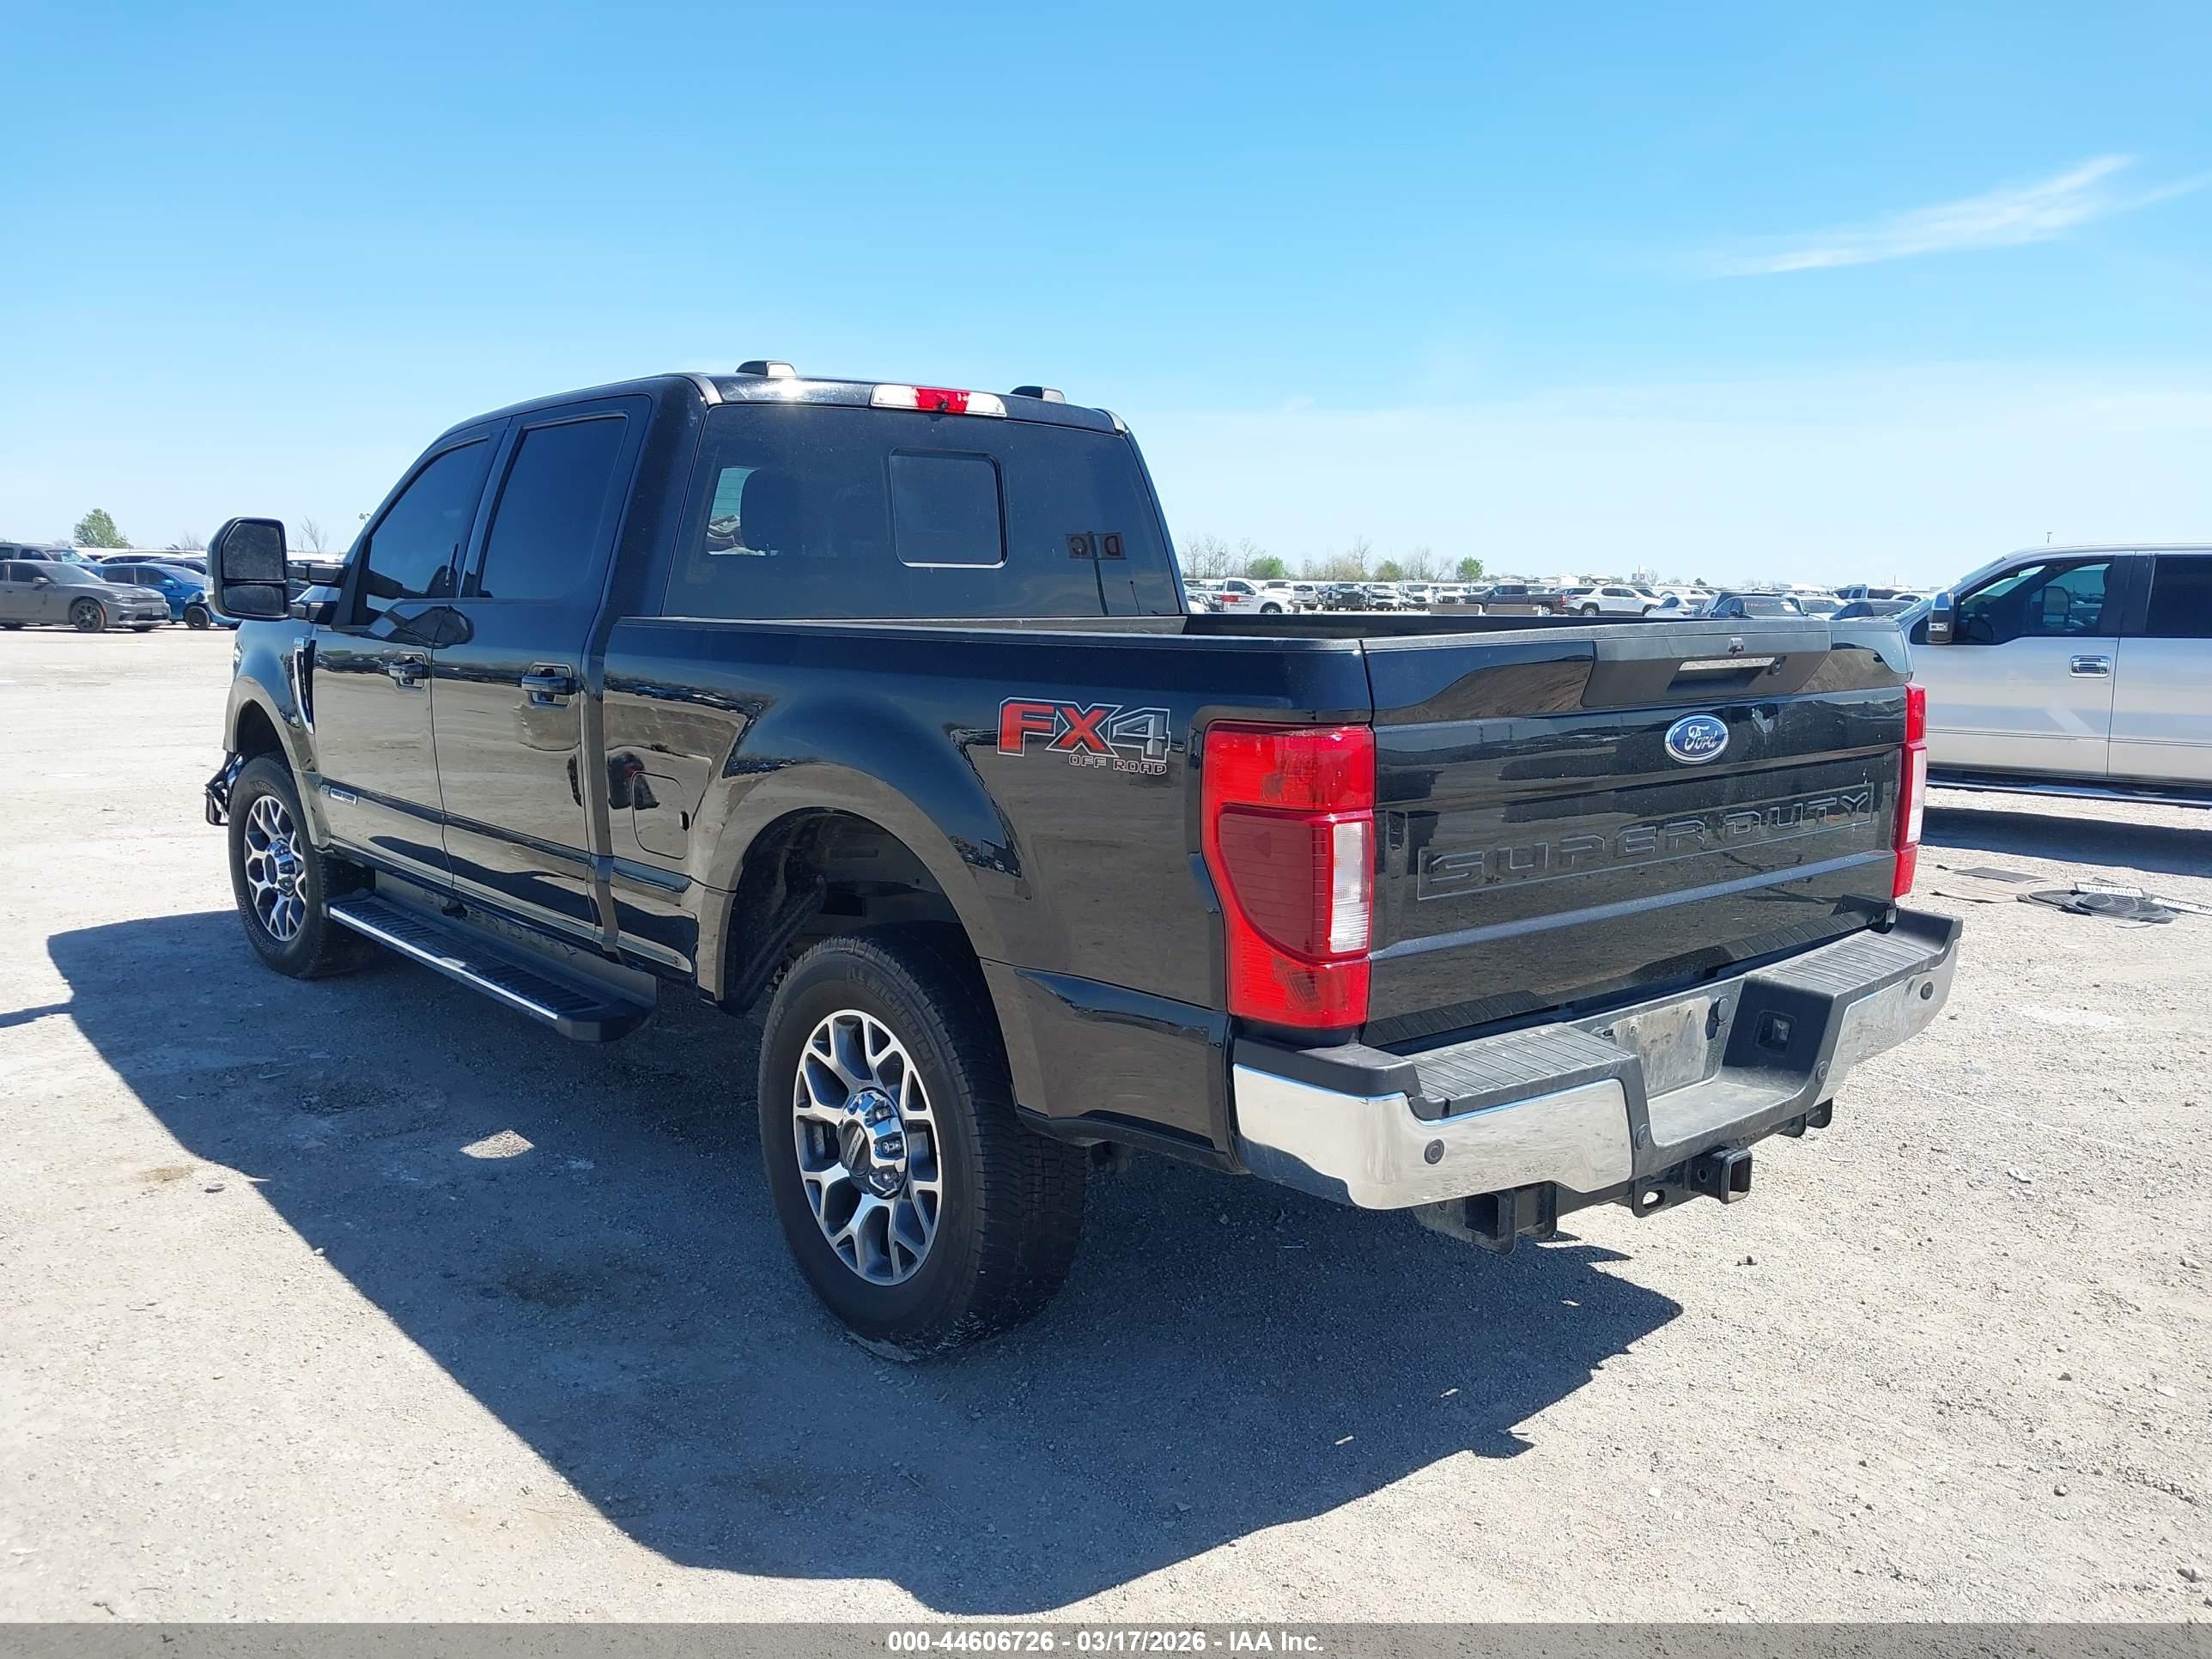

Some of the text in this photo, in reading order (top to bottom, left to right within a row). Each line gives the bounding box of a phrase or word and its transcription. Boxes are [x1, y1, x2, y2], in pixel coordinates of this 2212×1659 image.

[996, 696, 1170, 763] FX4
[1684, 725, 1718, 751] Ford
[1068, 754, 1167, 775] OFF ROAD
[1429, 791, 1869, 886] SUPER DUTY
